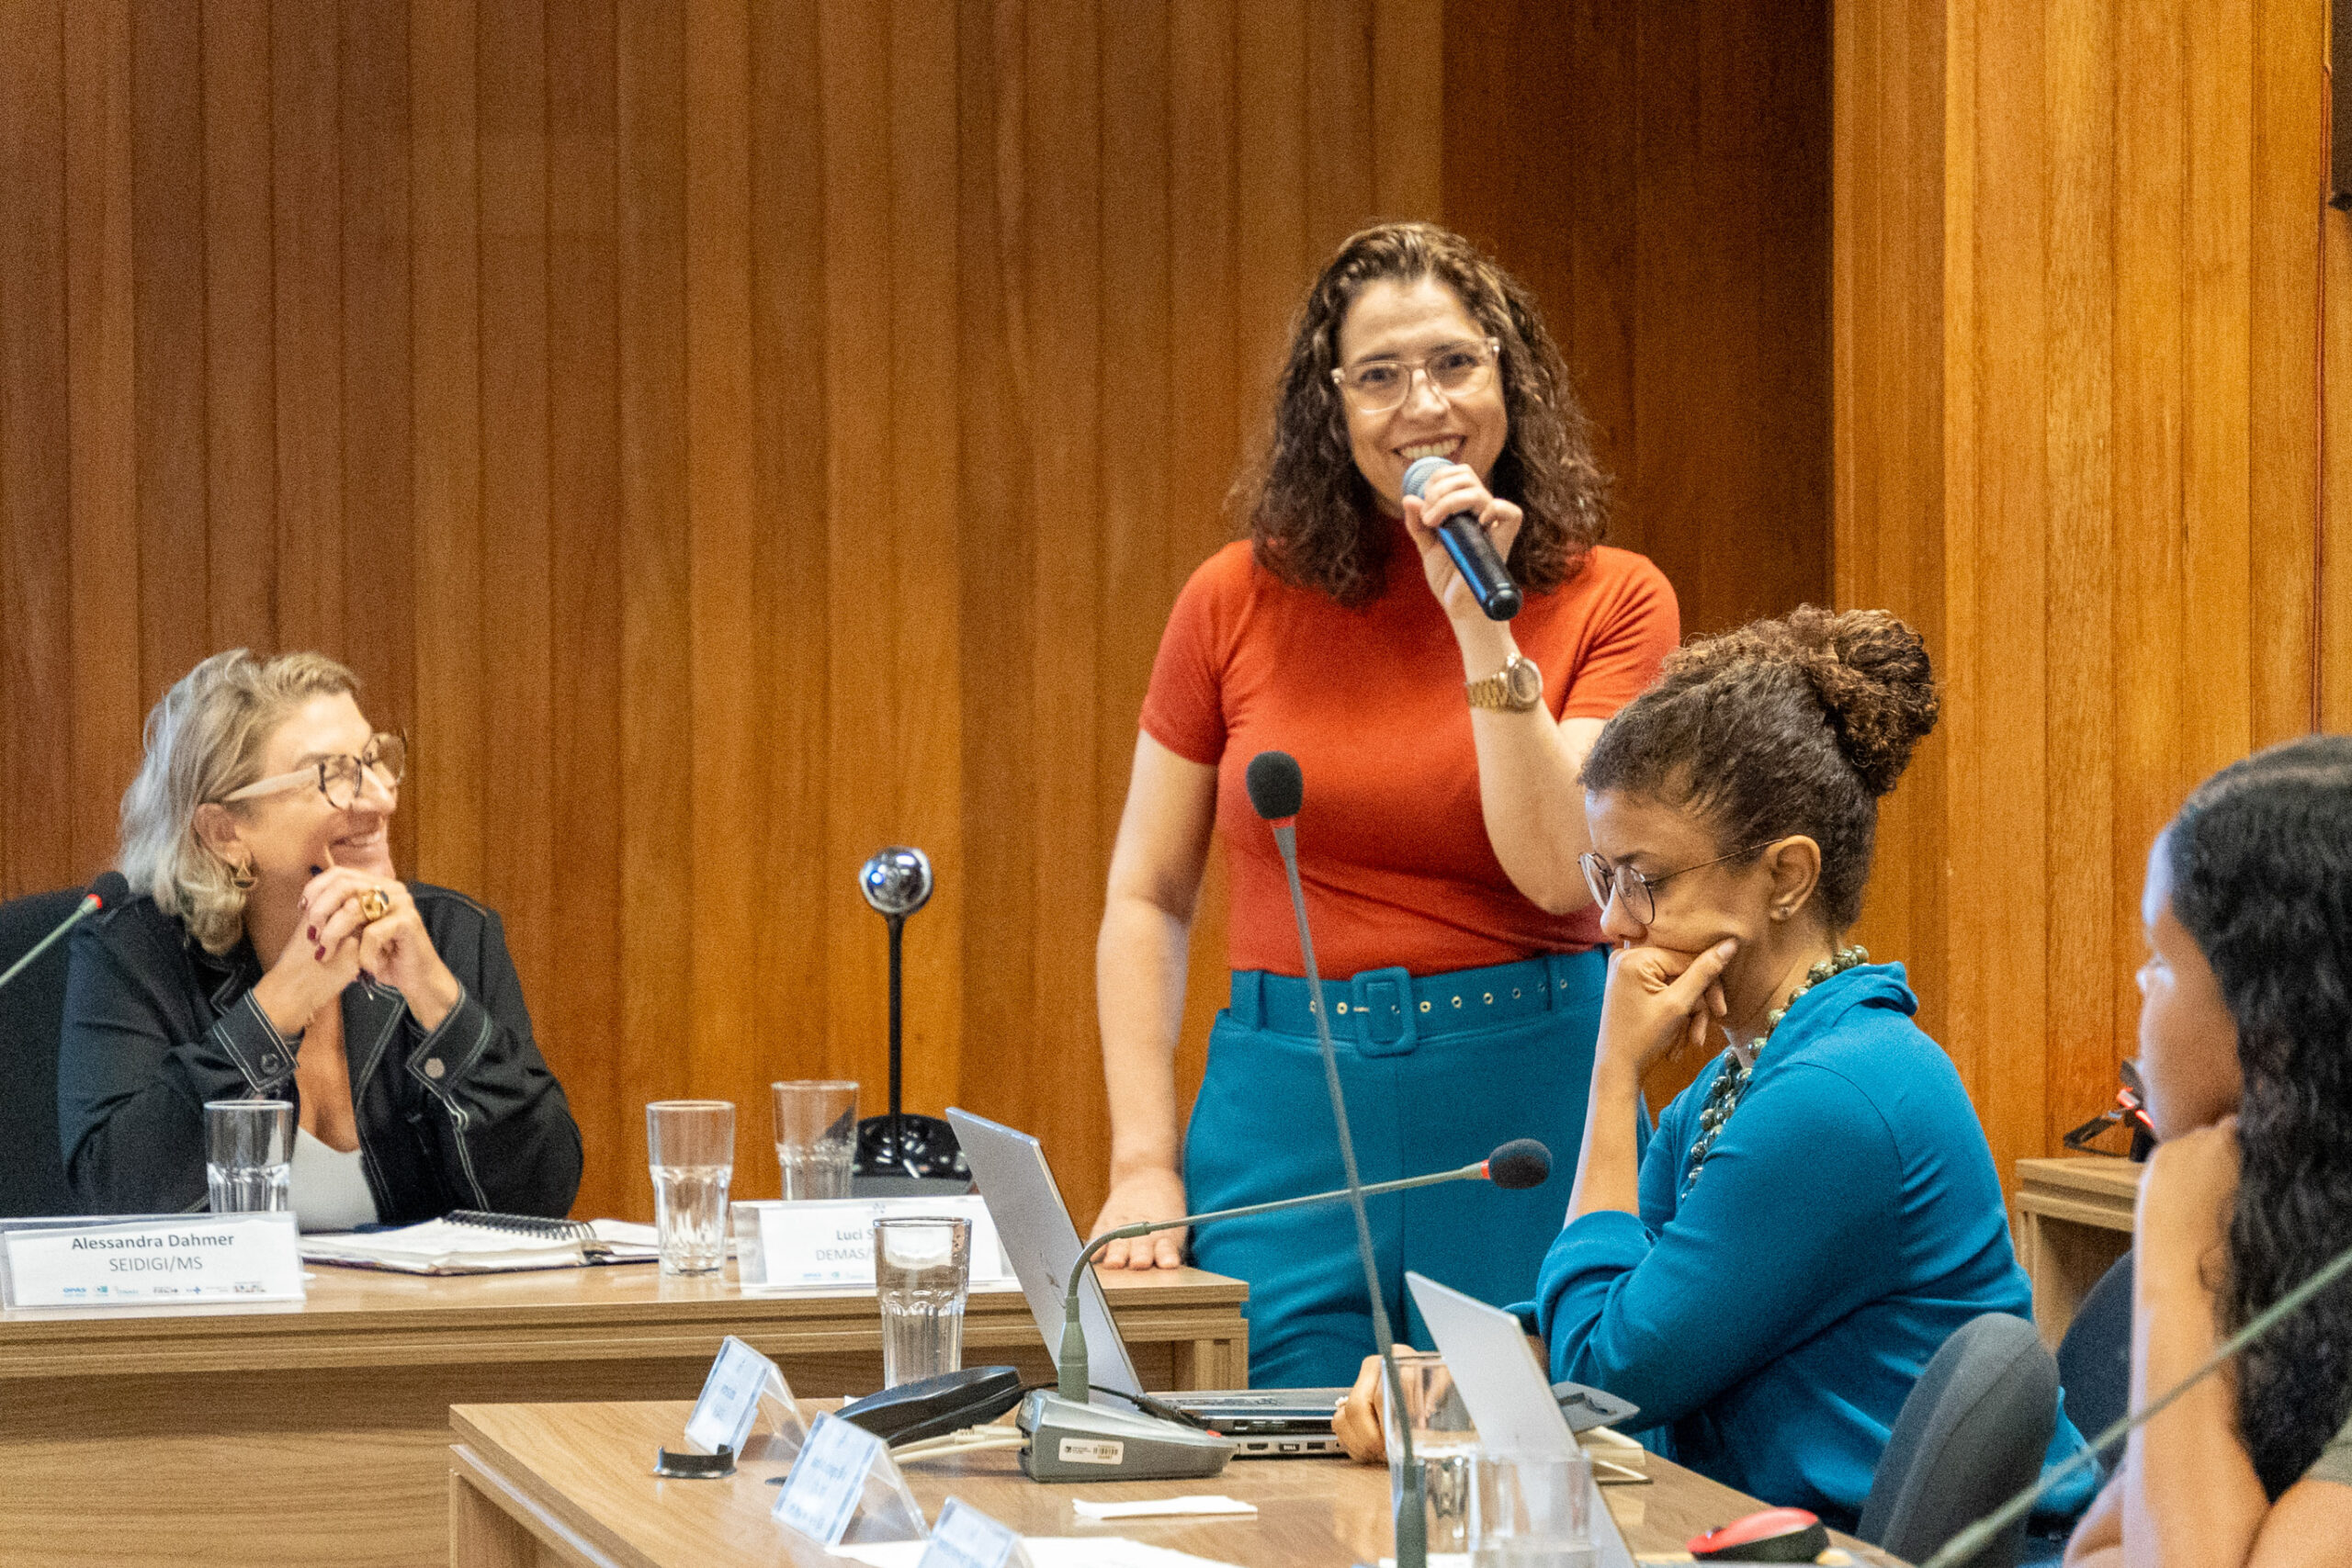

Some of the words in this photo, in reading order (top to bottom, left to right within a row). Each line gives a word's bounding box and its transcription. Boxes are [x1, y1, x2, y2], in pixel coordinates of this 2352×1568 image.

[836, 1228, 863, 1240] Luci
[72, 1236, 164, 1250] Alessandra
[168, 1234, 235, 1247] Dahmer
[816, 1247, 872, 1261] DEMAS/
[108, 1256, 204, 1272] SEIDIGI/MS
